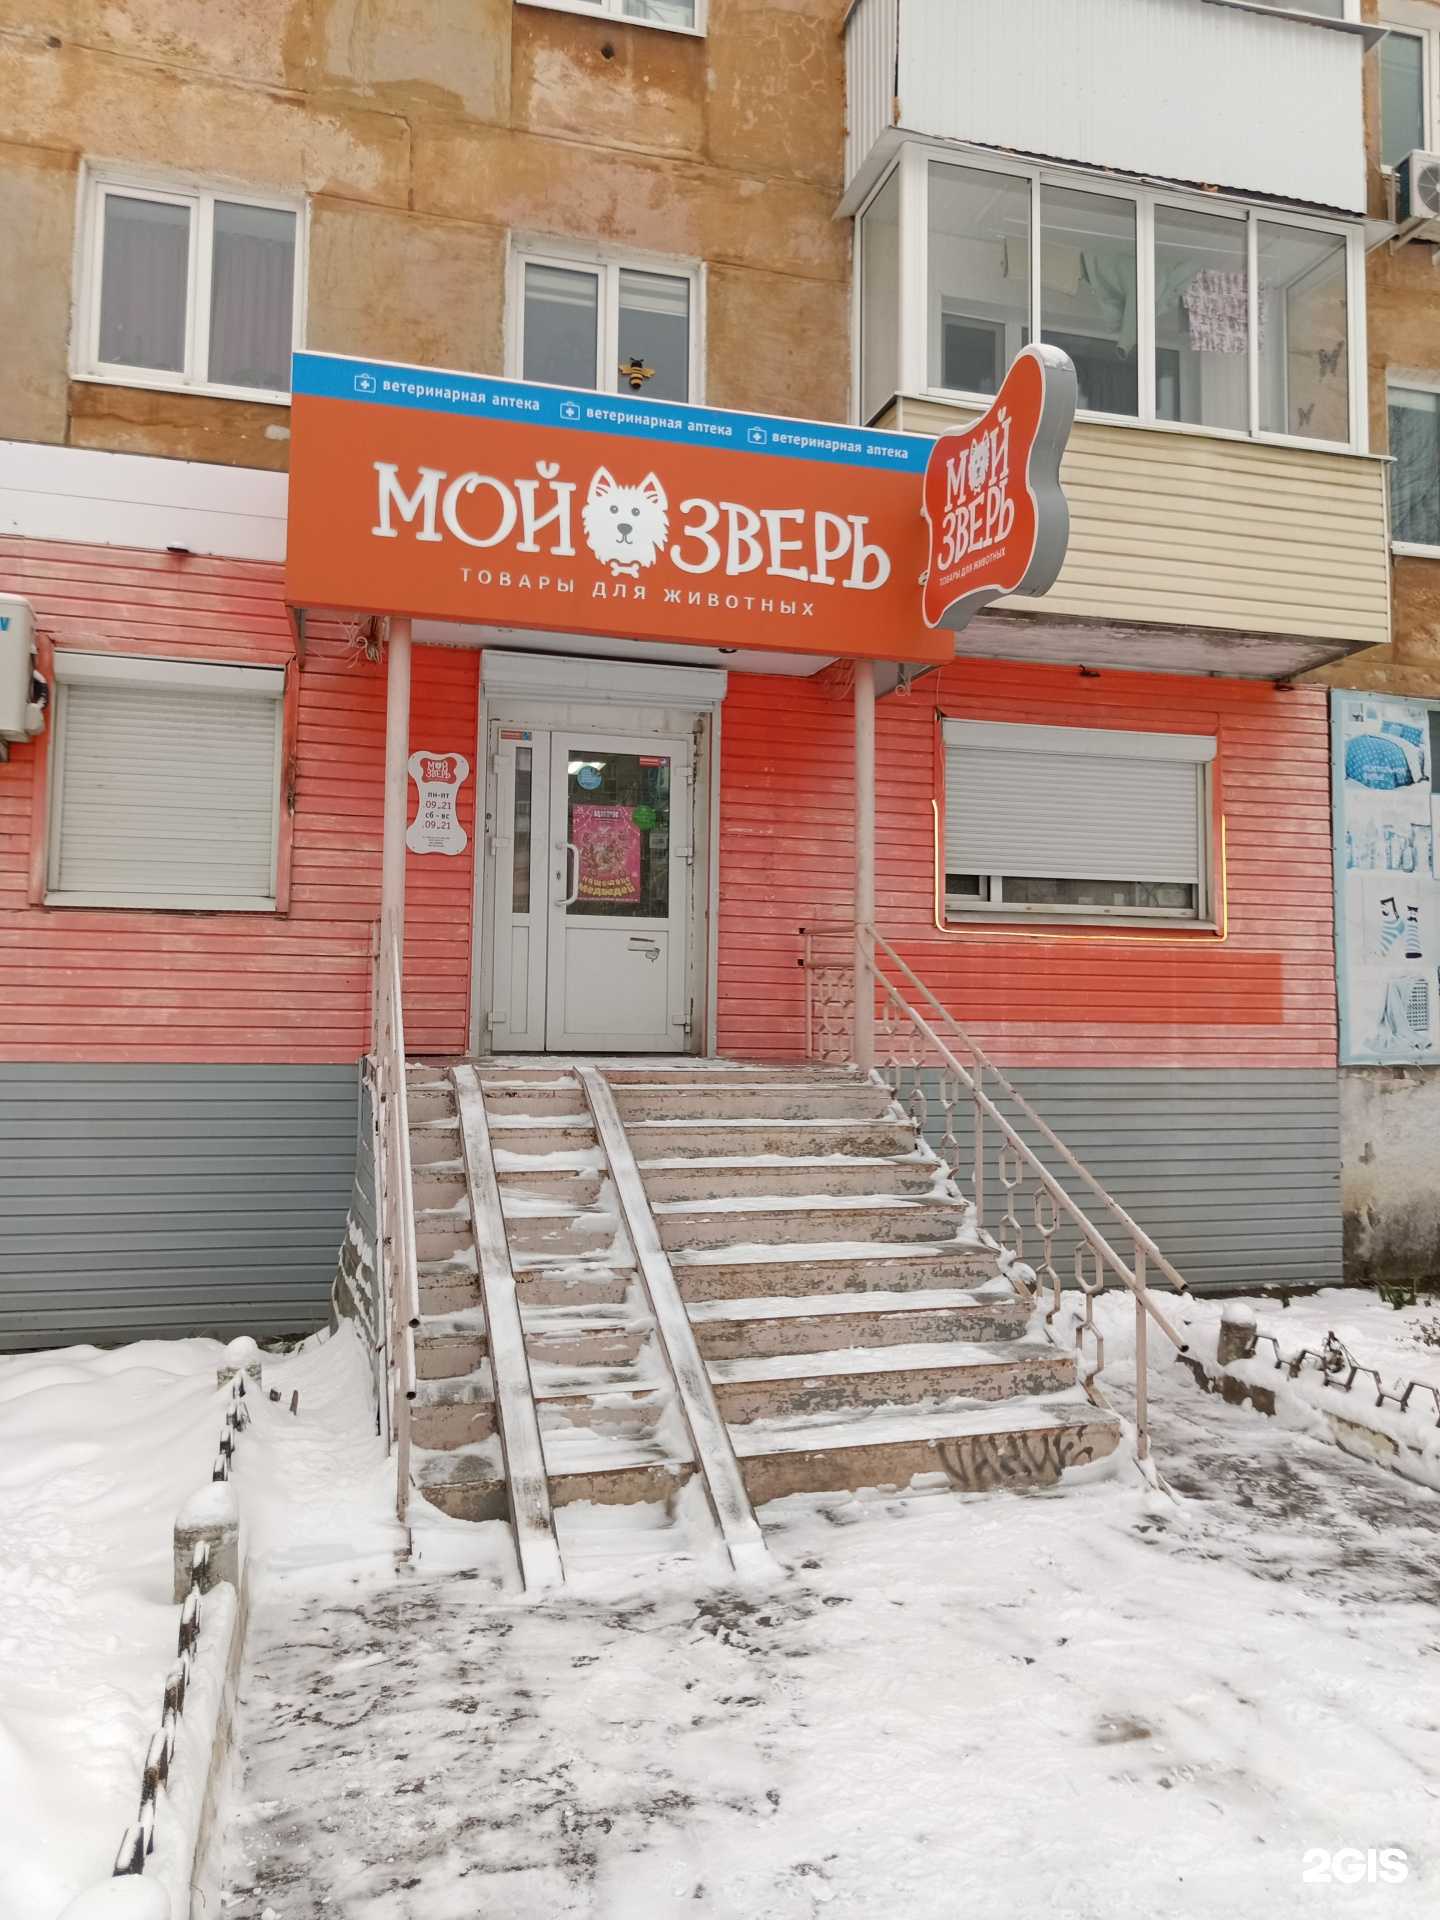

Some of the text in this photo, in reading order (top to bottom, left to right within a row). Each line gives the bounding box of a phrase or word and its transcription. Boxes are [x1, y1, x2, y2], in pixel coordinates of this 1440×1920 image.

[383, 379, 540, 411] ветеринарная аптека
[586, 406, 733, 436] ветеринарная аптека
[772, 432, 908, 460] ветеринарная аптека
[371, 460, 892, 591] МОЙ ЗВЕРЬ
[937, 477, 1015, 571] ЗВЕРЬ
[460, 567, 814, 616] ТОВАРЫ ДЛЯ ЖИВОТНЫХ
